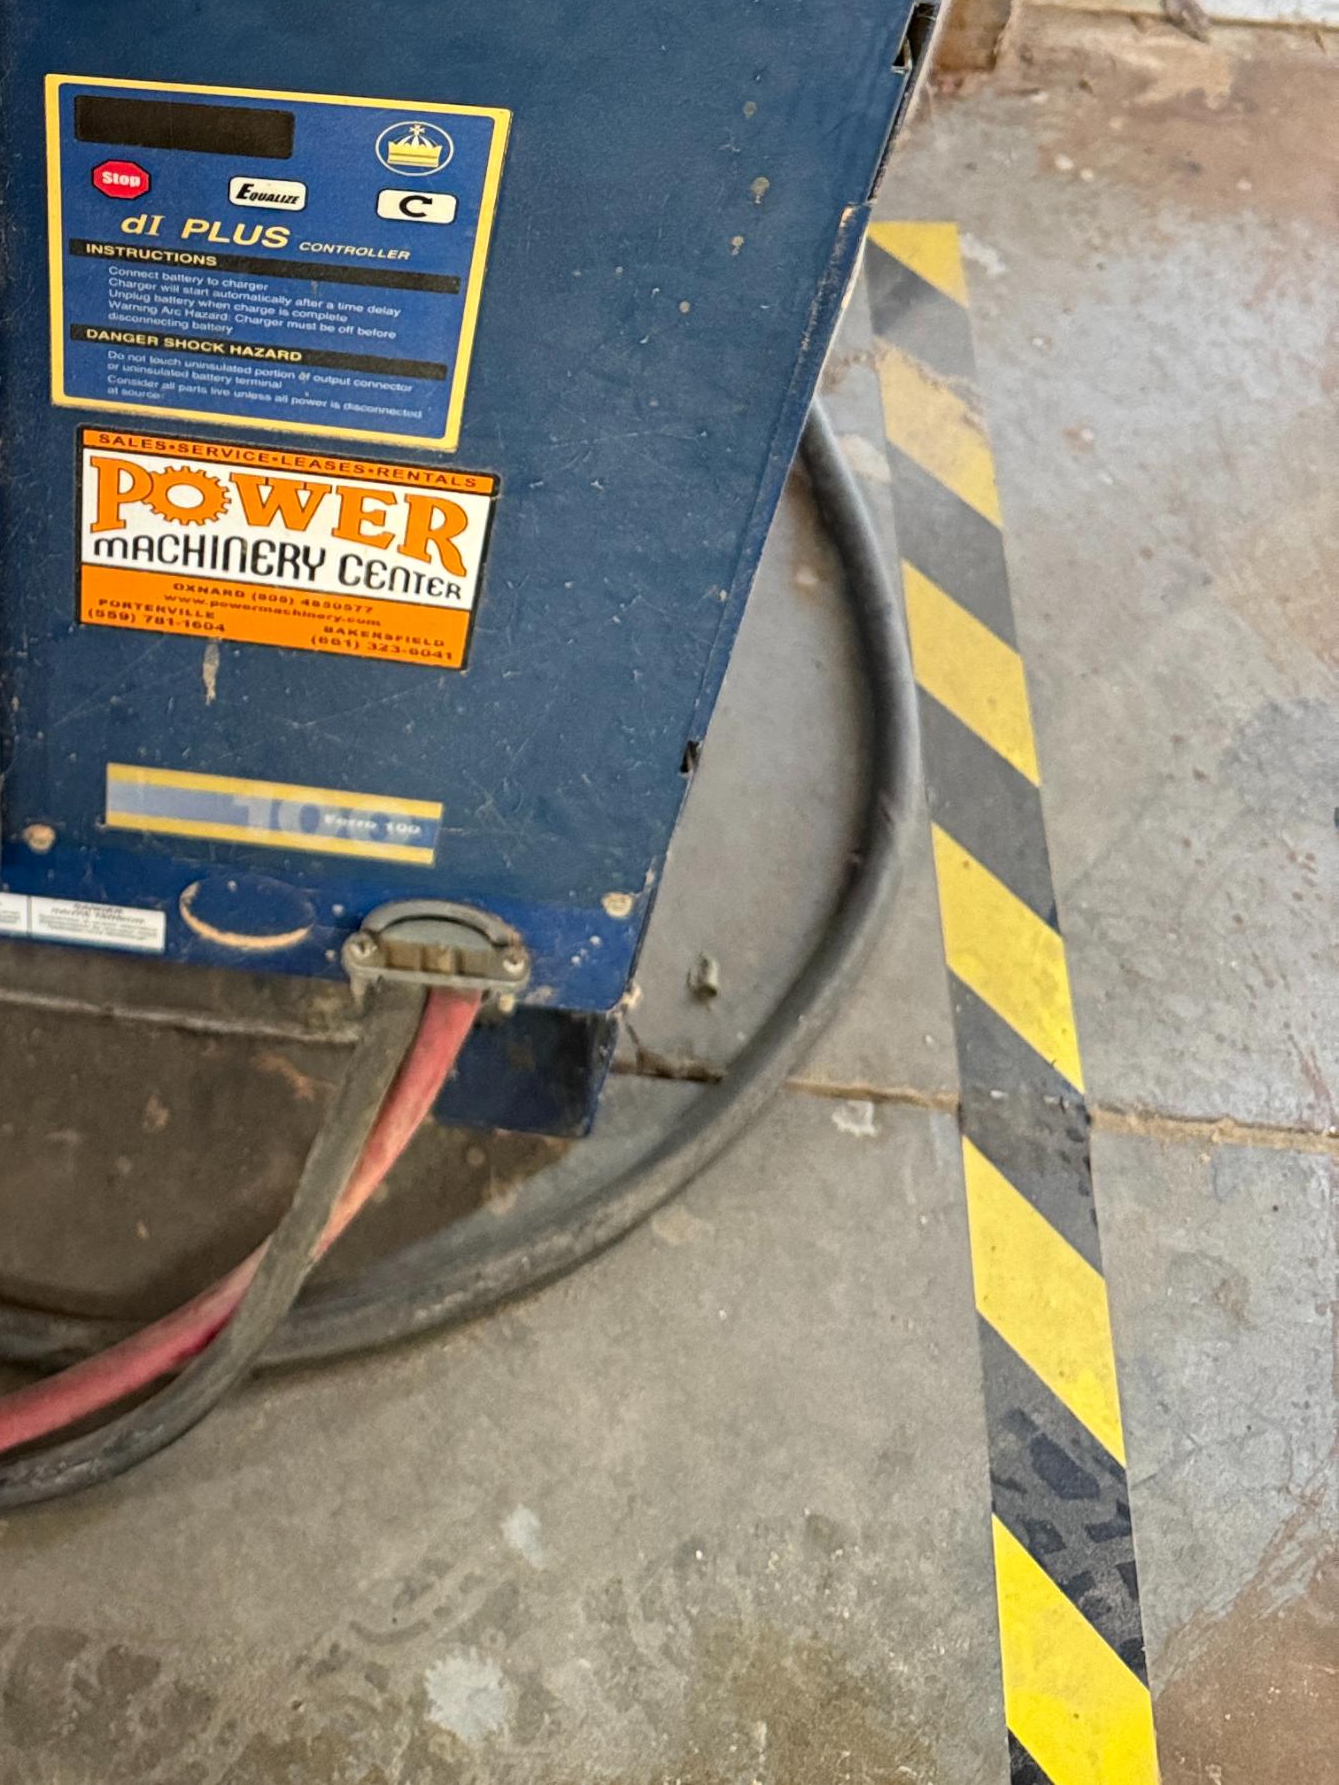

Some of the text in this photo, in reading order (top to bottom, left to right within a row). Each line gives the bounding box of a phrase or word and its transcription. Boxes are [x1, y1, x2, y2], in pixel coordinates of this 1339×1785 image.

[102, 171, 141, 187] Stop
[236, 183, 300, 205] EQUALIZE
[86, 243, 217, 266] INSTRUCTIONS
[180, 218, 291, 249] PLUS
[299, 241, 411, 260] CONTROLLER
[108, 266, 269, 291] Connect battery to charger
[108, 278, 401, 318] Charger will start automatically after a time delay
[108, 289, 348, 323] Unplug battery when charge is complete
[108, 300, 157, 315] Warning
[161, 306, 182, 316] Arc
[234, 313, 284, 327] Charger
[287, 320, 317, 331] must
[319, 323, 335, 333] be
[338, 326, 354, 335] off
[357, 327, 397, 340] before
[108, 312, 233, 335] disconnecting battery
[86, 328, 303, 362] DANGER SHOCK HAZARD
[107, 350, 413, 392] Do not touch uninsulated portion of output connector
[122, 365, 189, 379] uninsulated
[192, 371, 232, 385] battery
[235, 375, 283, 389] terminal
[107, 387, 118, 395] at
[107, 374, 422, 419] Consider all parts live unless all power is disconnected
[90, 455, 469, 578] POWER
[173, 582, 245, 598] OXNARD
[338, 553, 462, 600] CENTER
[99, 599, 215, 619] PORTERVILLE
[323, 625, 445, 647] BAKERSFIELD
